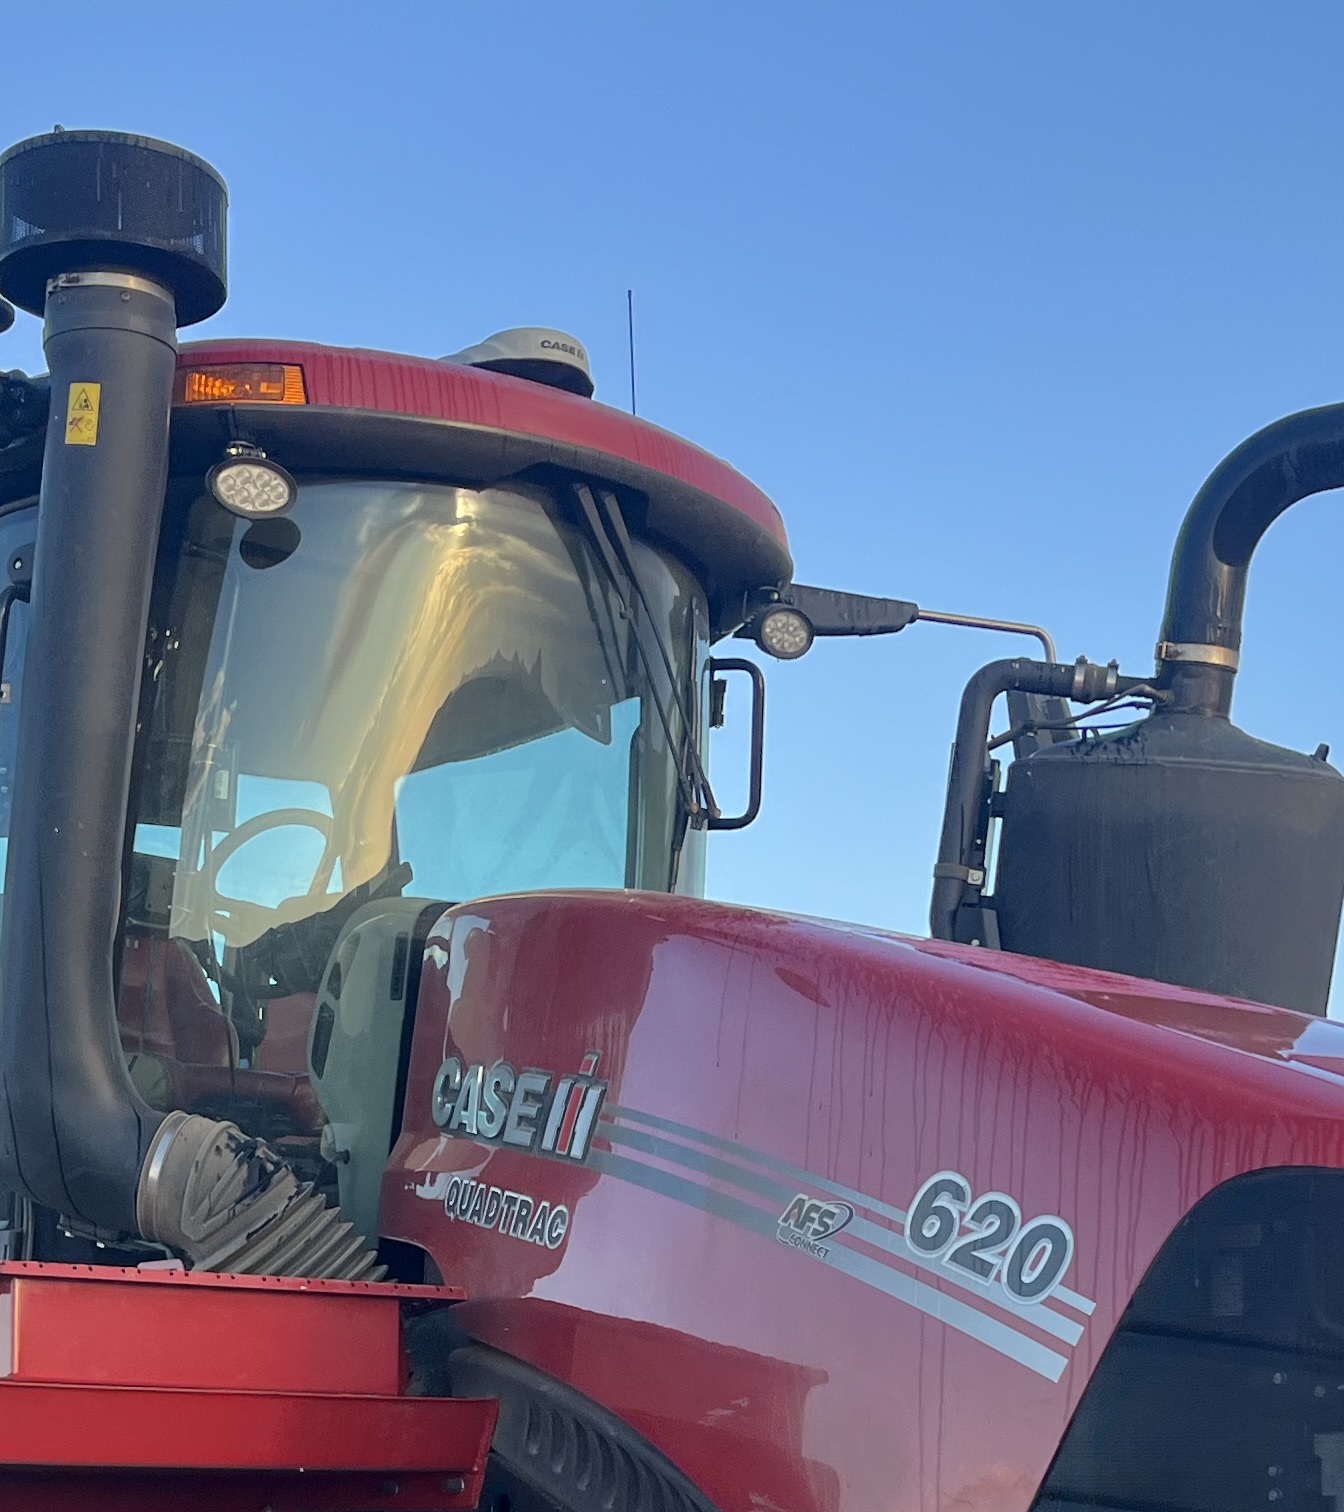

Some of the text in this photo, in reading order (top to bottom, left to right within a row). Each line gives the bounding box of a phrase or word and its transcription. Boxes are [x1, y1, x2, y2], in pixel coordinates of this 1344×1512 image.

[540, 339, 576, 356] CASE
[432, 1056, 553, 1148] CASE
[445, 1176, 569, 1250] QUADTRAC
[778, 1195, 839, 1239] AFS
[904, 1170, 1074, 1305] 620
[787, 1232, 830, 1260] CONNECT
